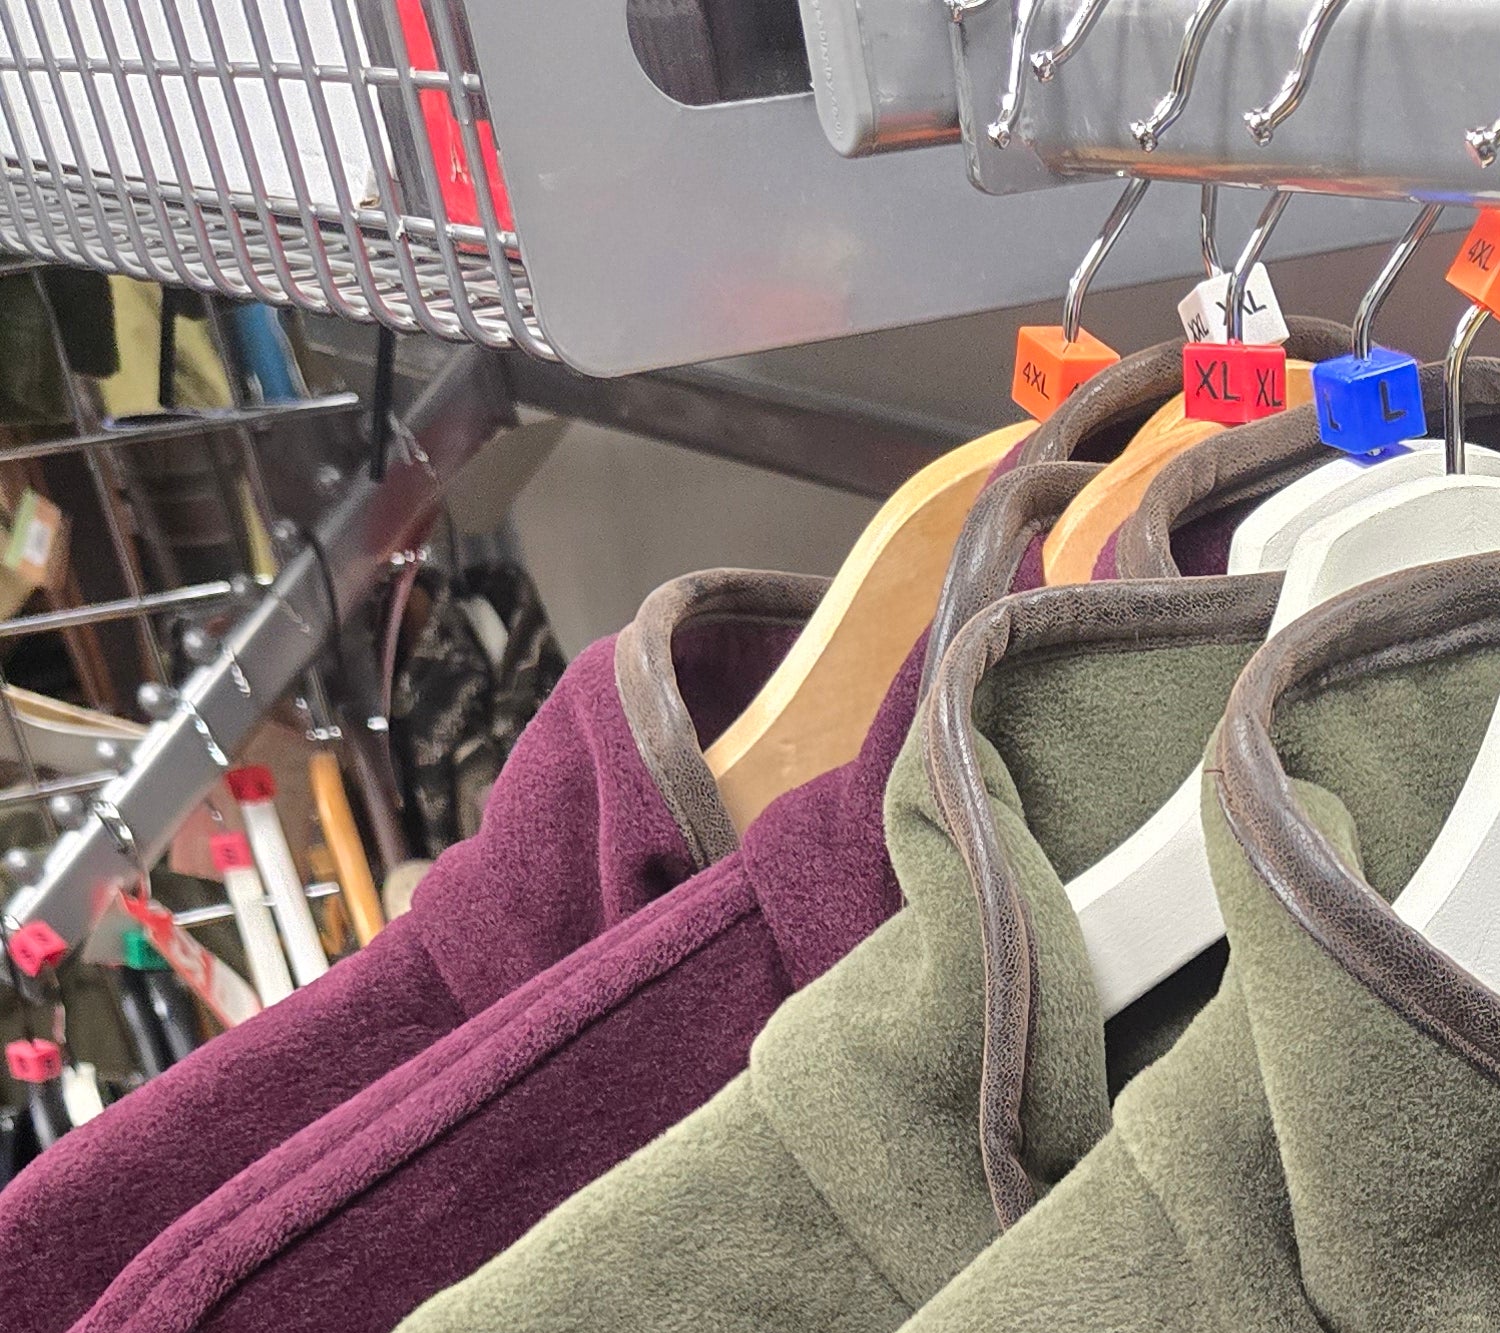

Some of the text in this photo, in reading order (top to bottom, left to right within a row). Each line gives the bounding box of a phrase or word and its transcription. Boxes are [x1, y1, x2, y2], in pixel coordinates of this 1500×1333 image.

[1467, 237, 1496, 272] 4XL
[1022, 361, 1051, 400] 4XL
[1195, 359, 1242, 402] XL
[1255, 367, 1282, 407] XL
[1379, 380, 1407, 421] L
